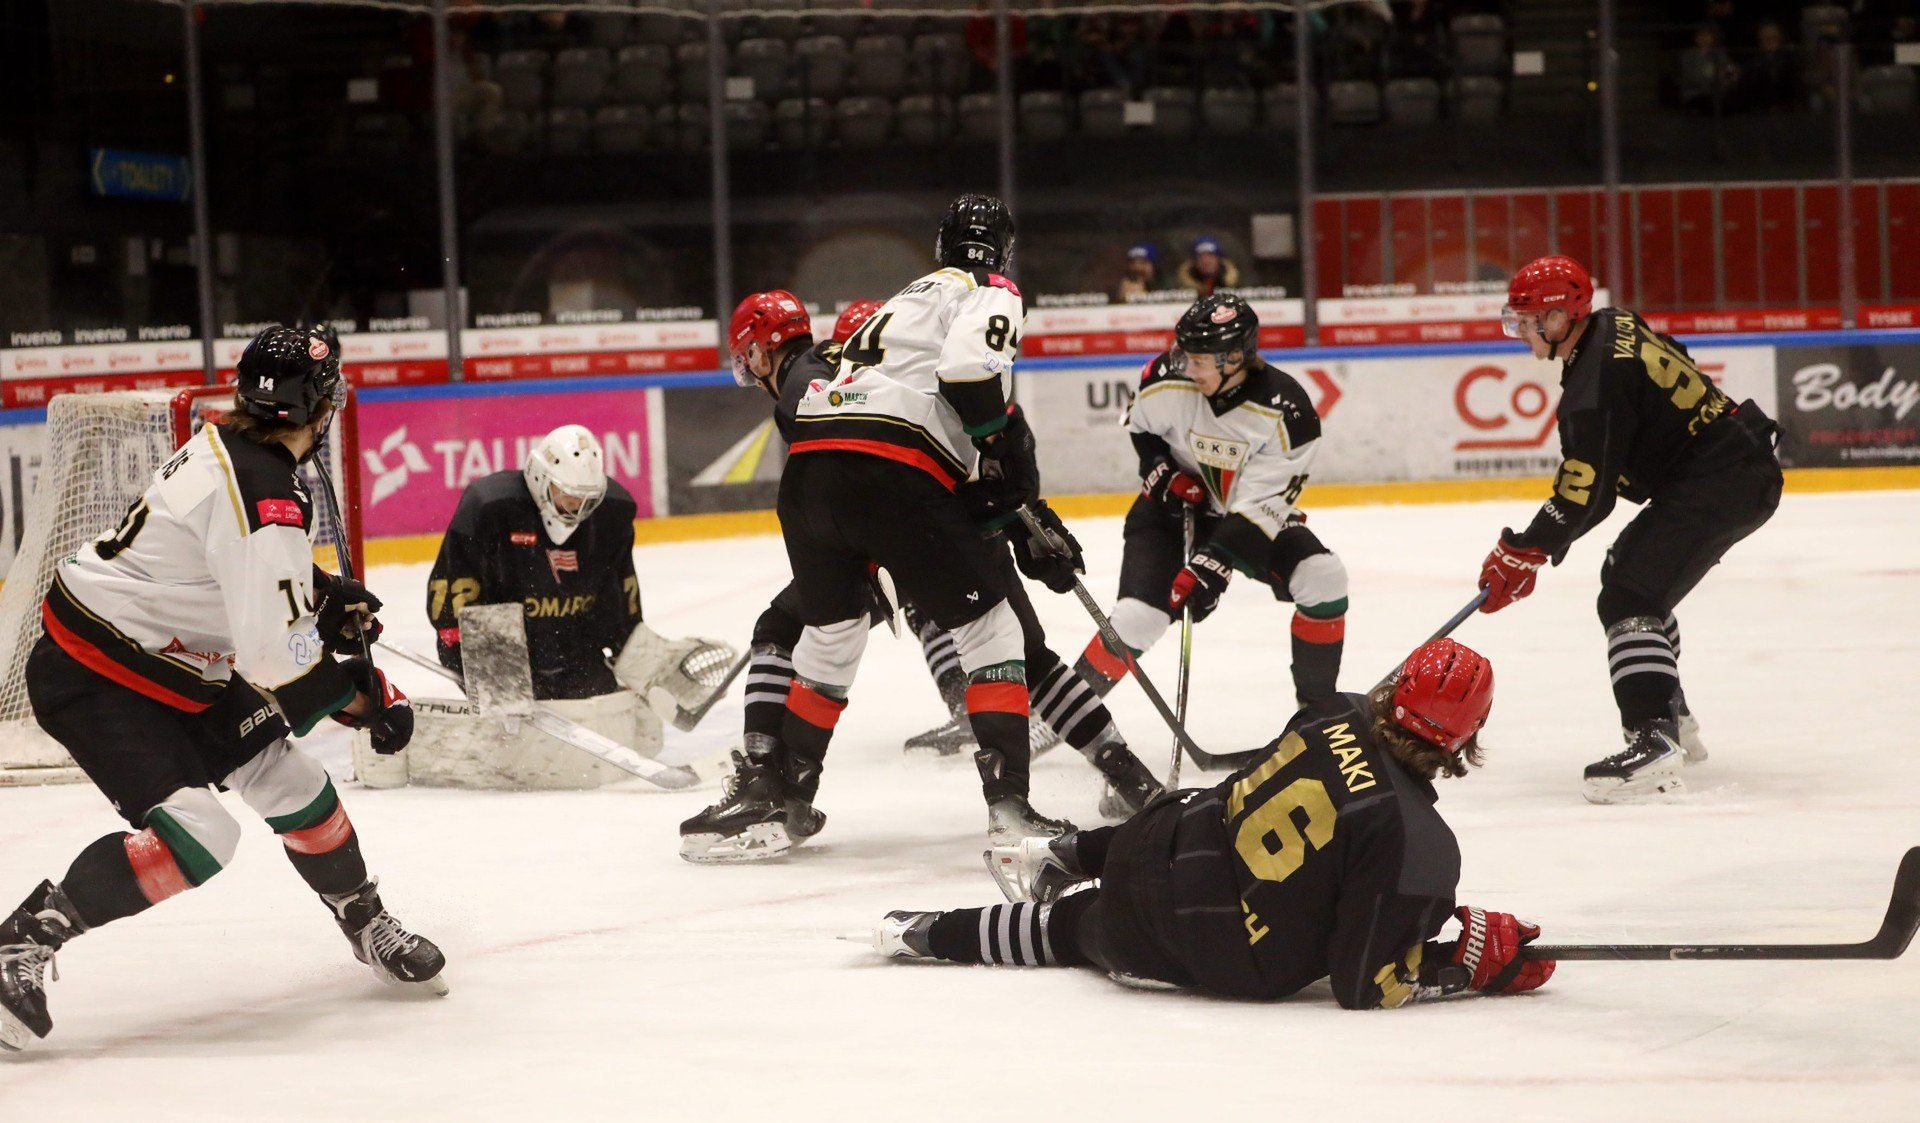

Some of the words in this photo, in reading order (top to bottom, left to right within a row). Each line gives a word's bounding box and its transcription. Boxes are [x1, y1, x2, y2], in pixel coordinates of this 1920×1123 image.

[967, 248, 984, 261] 84
[259, 376, 274, 391] 14
[1793, 363, 1920, 421] Body
[433, 431, 640, 490] TAUN
[1322, 722, 1376, 793] MAKI
[1227, 730, 1338, 882] 16
[1466, 906, 1488, 980] ARRIO
